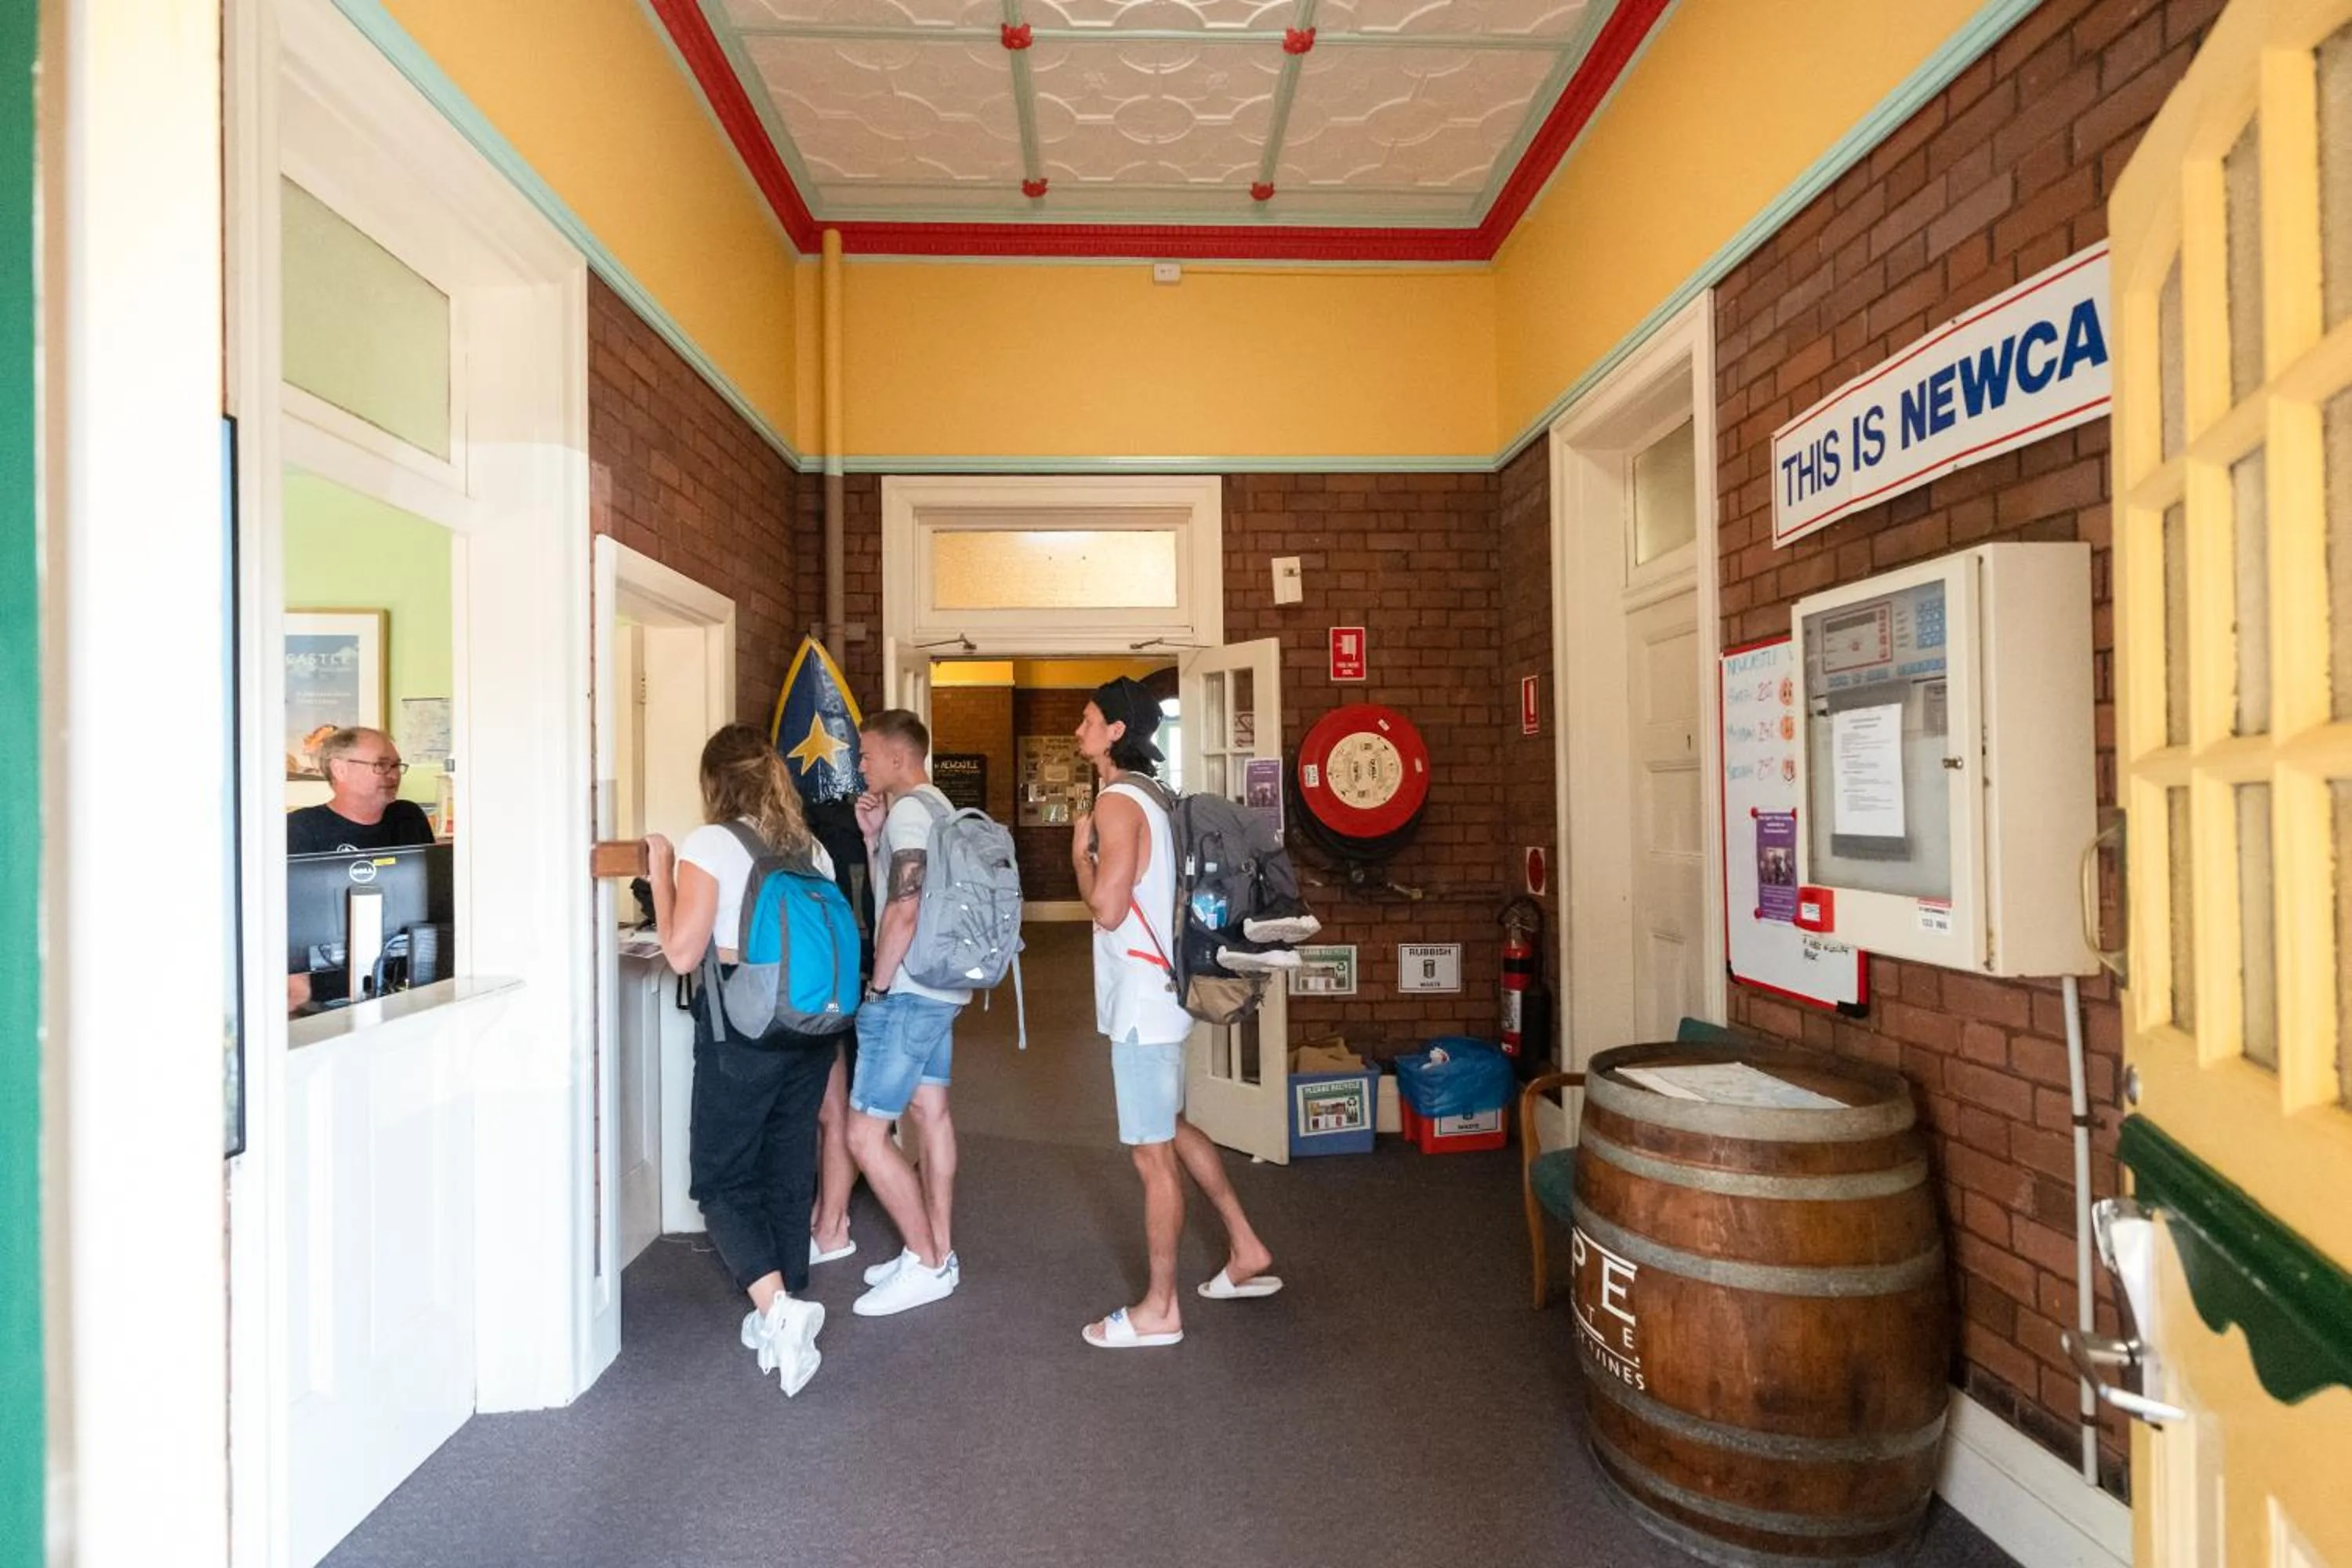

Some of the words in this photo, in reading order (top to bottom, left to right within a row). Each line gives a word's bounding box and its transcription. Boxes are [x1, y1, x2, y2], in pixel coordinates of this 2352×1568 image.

[1781, 430, 1841, 507] THIS
[1853, 405, 1886, 472] IS
[1901, 297, 2108, 451] NEWCA
[1409, 948, 1451, 956] RUBBISH
